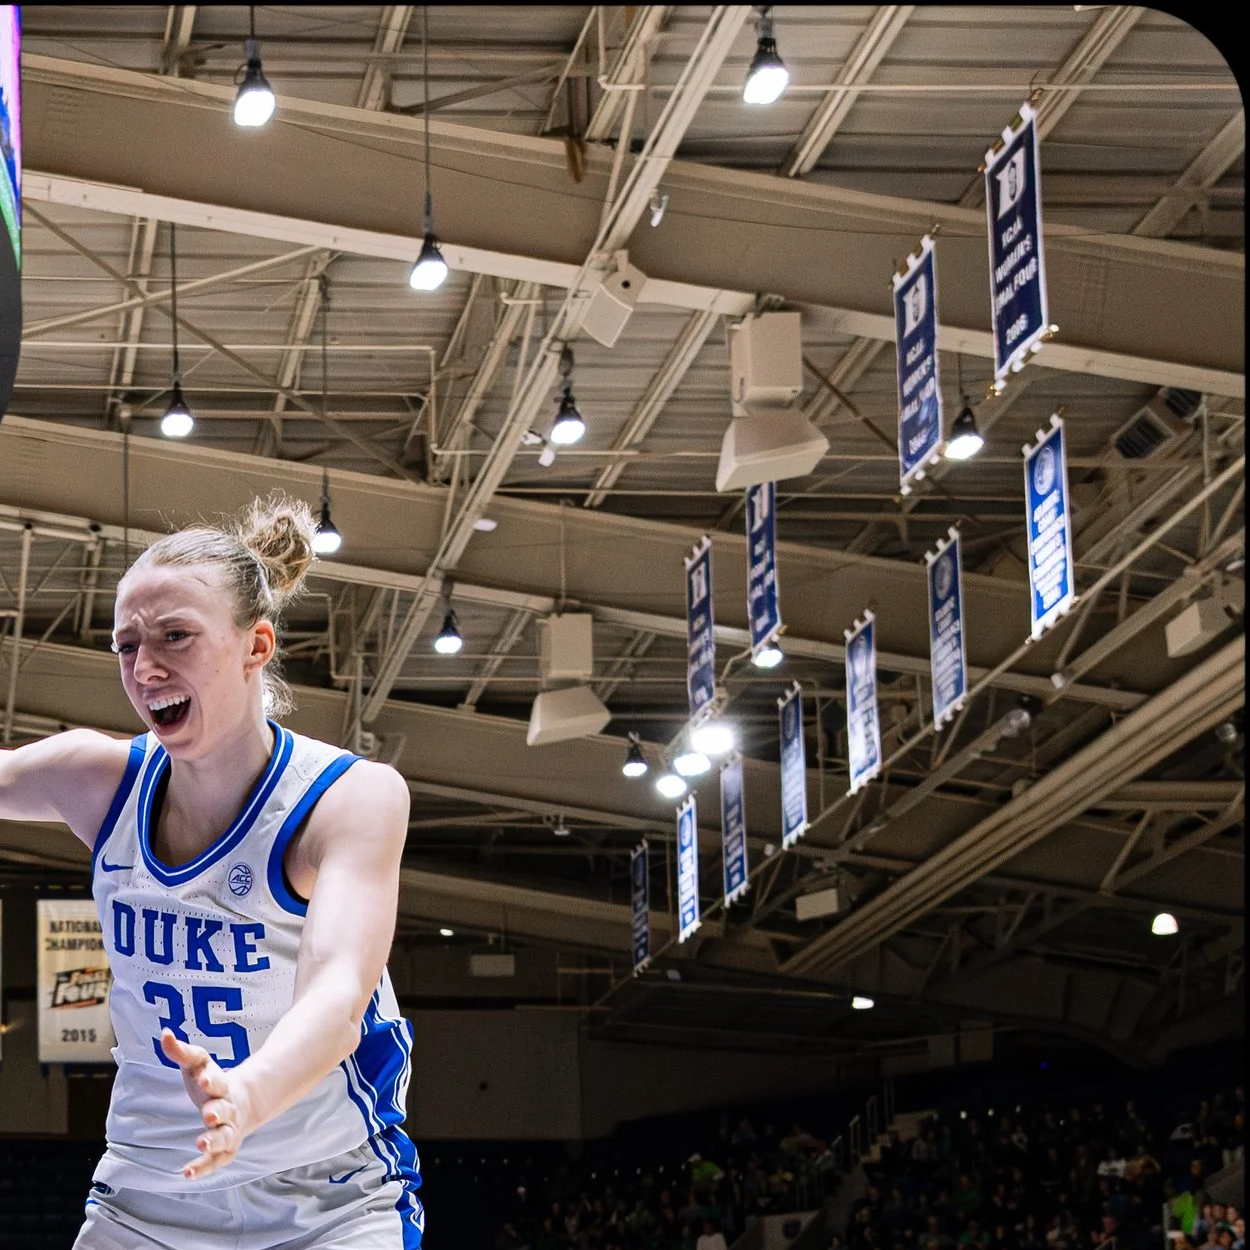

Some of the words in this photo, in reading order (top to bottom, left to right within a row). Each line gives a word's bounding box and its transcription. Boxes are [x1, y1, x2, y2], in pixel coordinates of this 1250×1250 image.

[49, 919, 103, 934] NATIONA
[111, 899, 271, 974] DUKE
[61, 1028, 98, 1043] 2015
[141, 979, 252, 1071] 35
